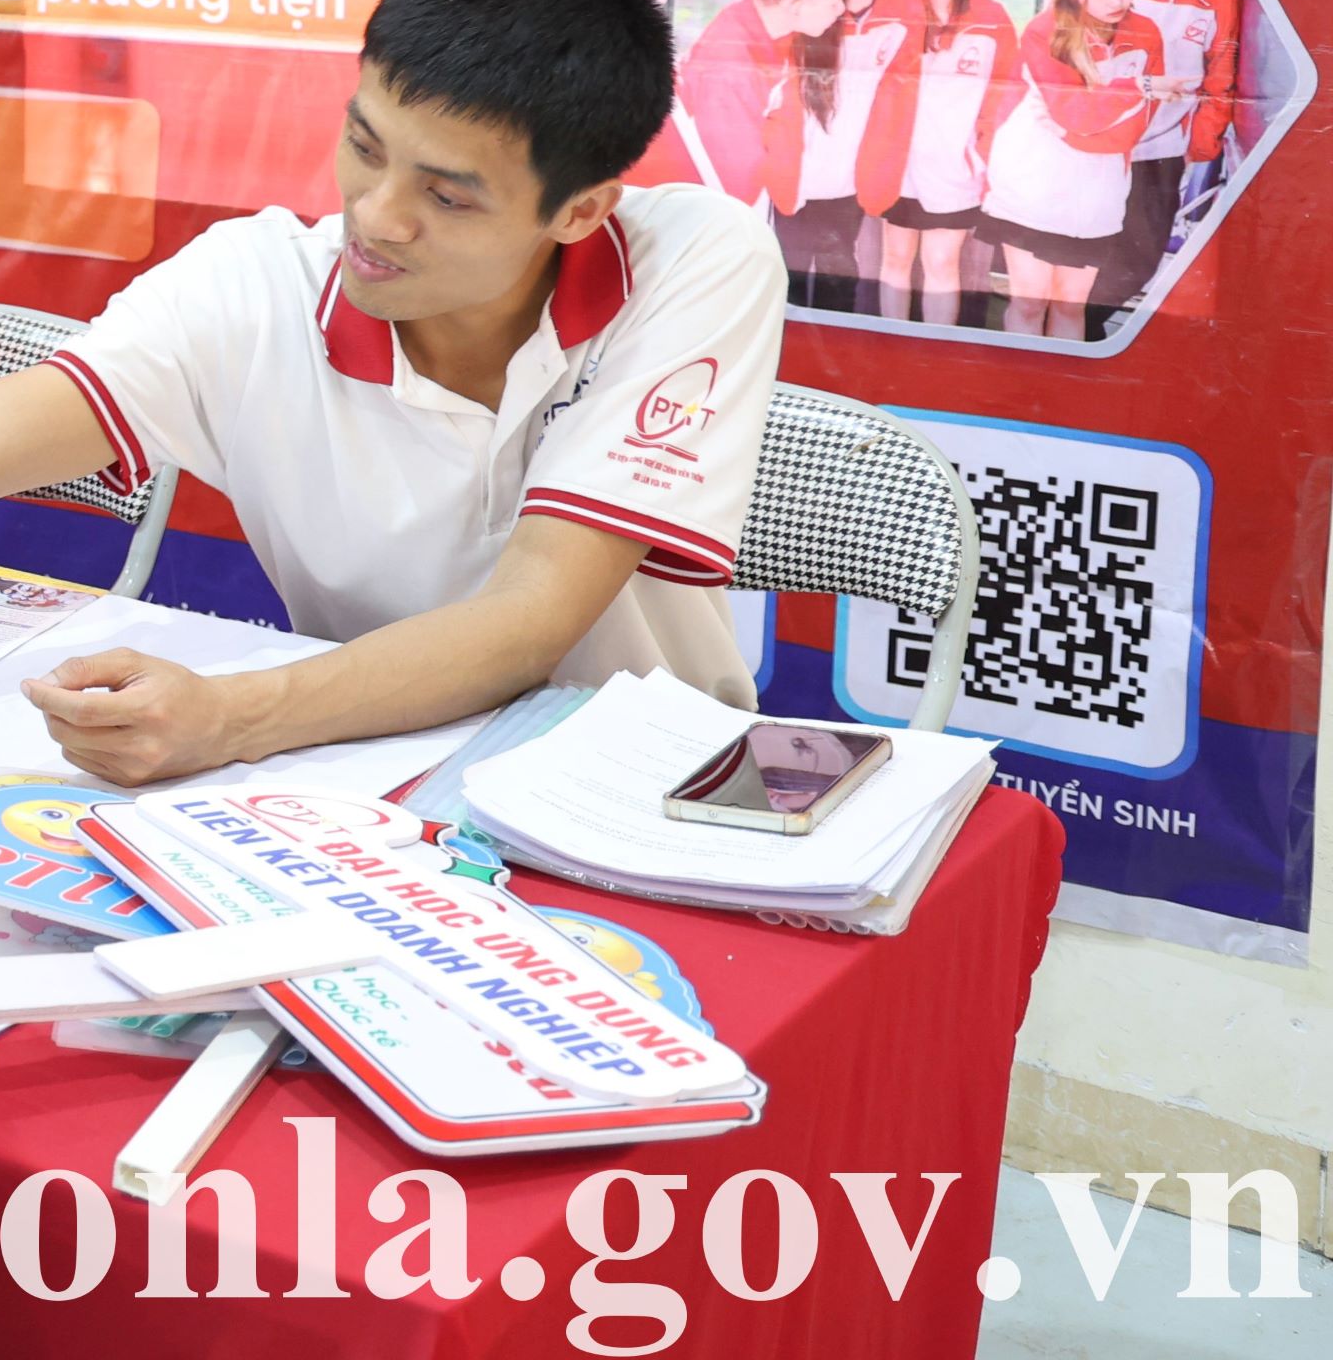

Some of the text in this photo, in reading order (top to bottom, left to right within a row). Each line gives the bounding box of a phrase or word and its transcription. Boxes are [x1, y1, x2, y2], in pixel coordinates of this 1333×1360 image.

[1113, 799, 1196, 838] SINH
[171, 800, 271, 845] LIÊN
[255, 848, 346, 886] KẾT
[328, 891, 482, 974] DOANH
[467, 978, 645, 1076] NGHIỆP
[315, 841, 401, 880] ĐẠI
[384, 882, 484, 928] HỌC
[473, 932, 577, 987] ỨNG
[565, 991, 707, 1068] DỤNG
[311, 978, 408, 1049] Quốc tế
[353, 976, 400, 1011] học
